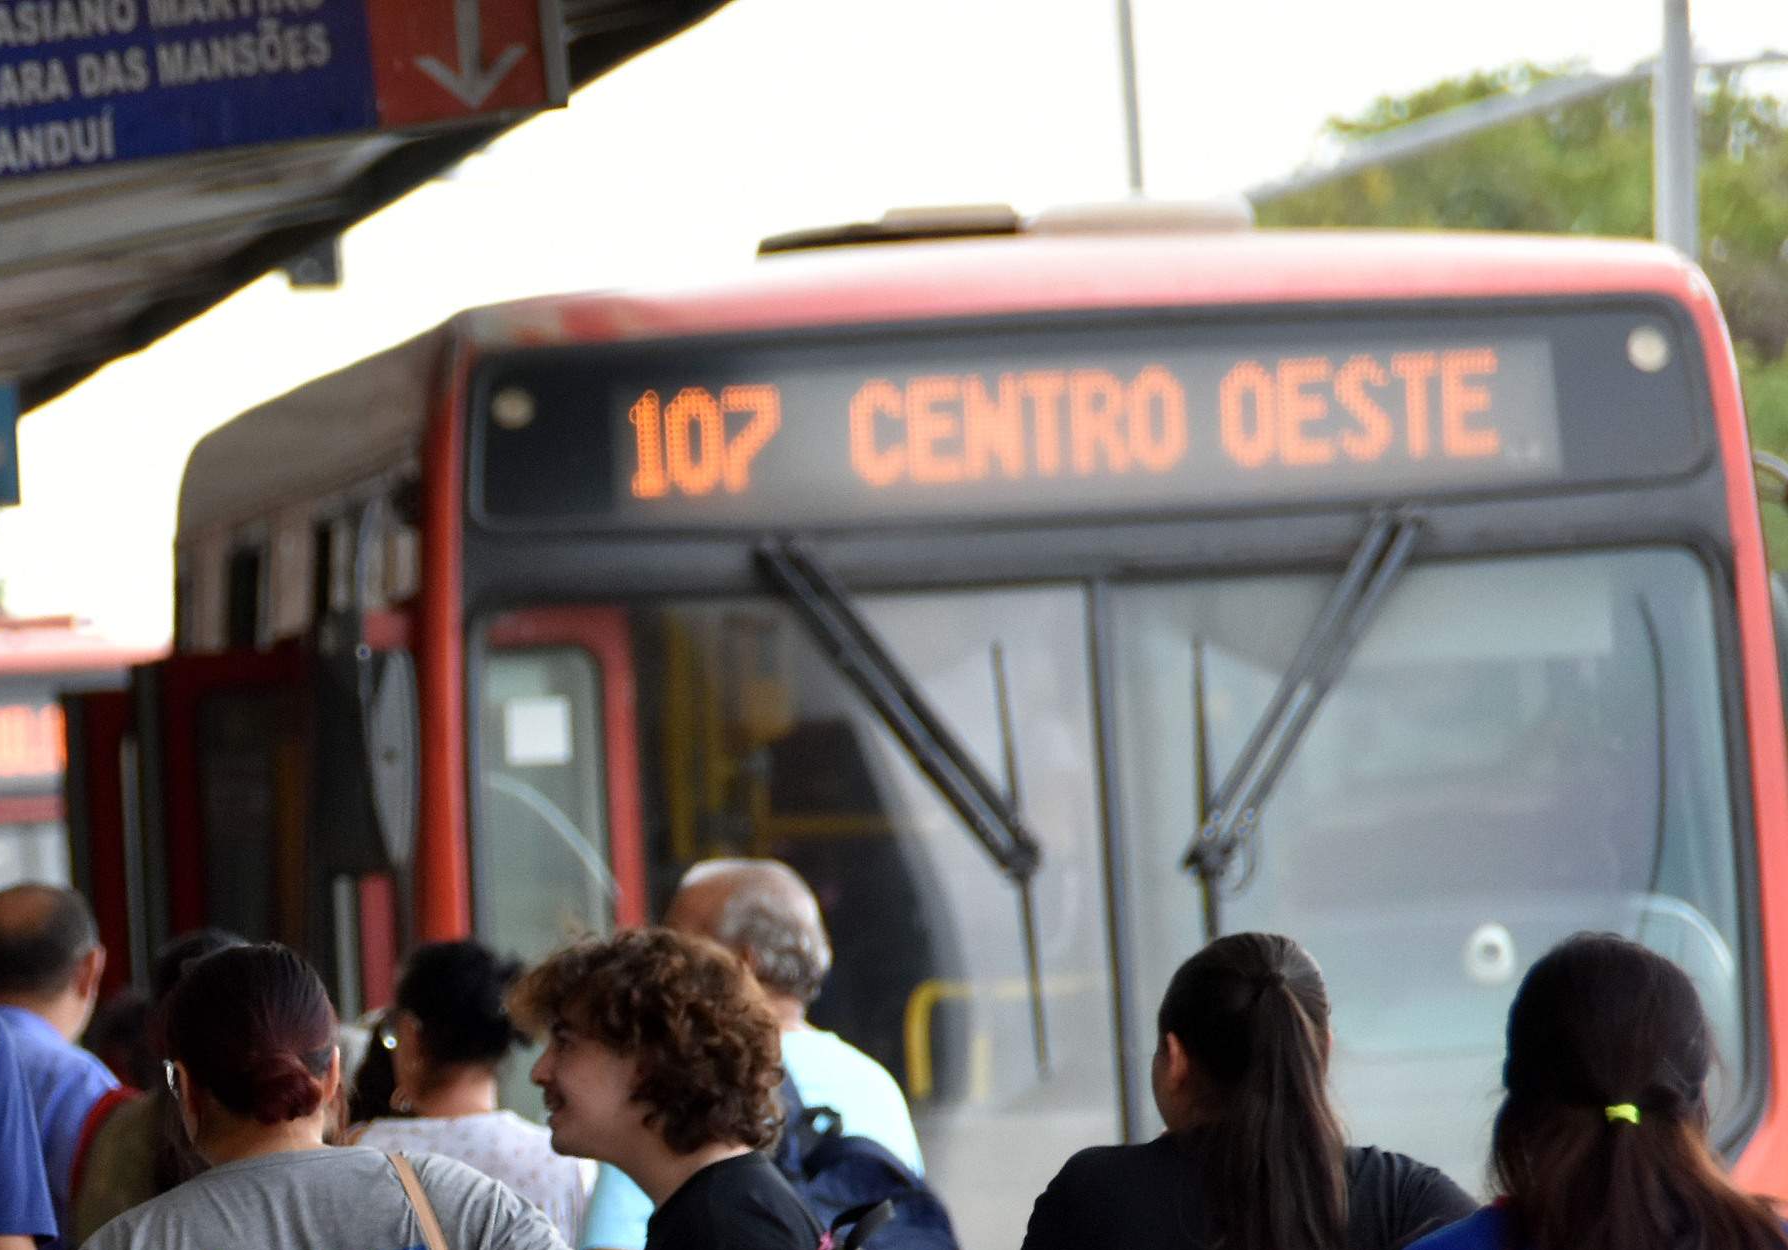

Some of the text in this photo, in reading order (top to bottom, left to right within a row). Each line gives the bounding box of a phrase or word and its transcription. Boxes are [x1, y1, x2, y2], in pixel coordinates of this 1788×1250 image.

[77, 46, 150, 98] DAS
[156, 17, 332, 88] MANSÕES
[628, 347, 1501, 499] 107 CENTRO OESTE
